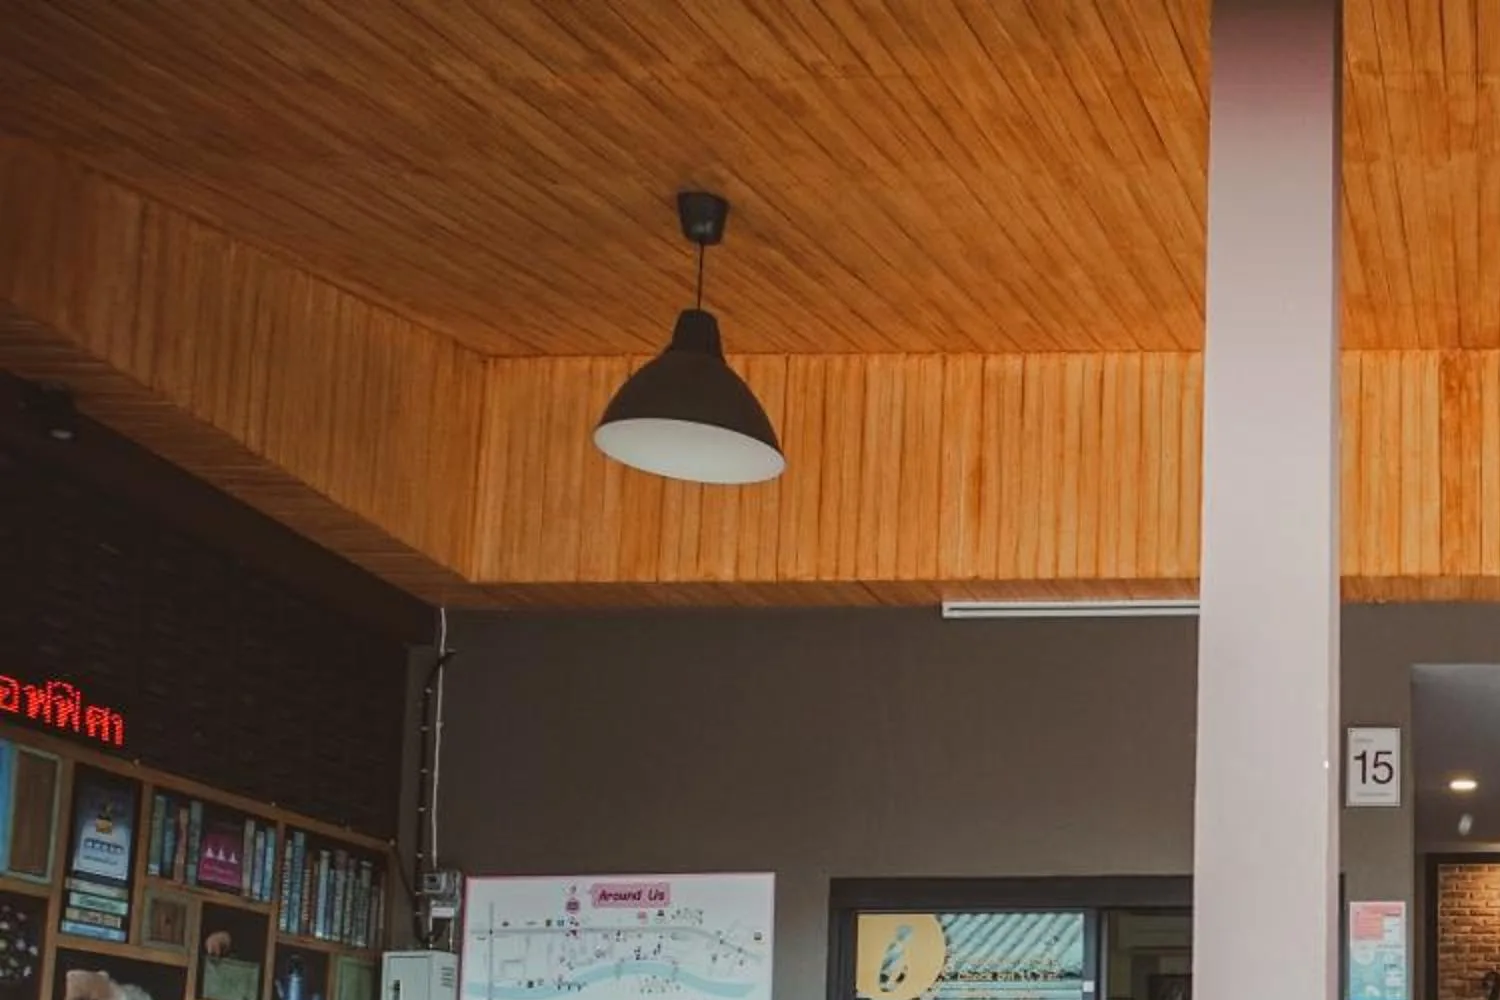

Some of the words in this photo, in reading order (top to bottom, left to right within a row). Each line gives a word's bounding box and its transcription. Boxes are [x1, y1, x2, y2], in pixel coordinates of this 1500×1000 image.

[1354, 750, 1393, 784] 15
[598, 889, 643, 901] Around
[647, 888, 664, 901] Us
